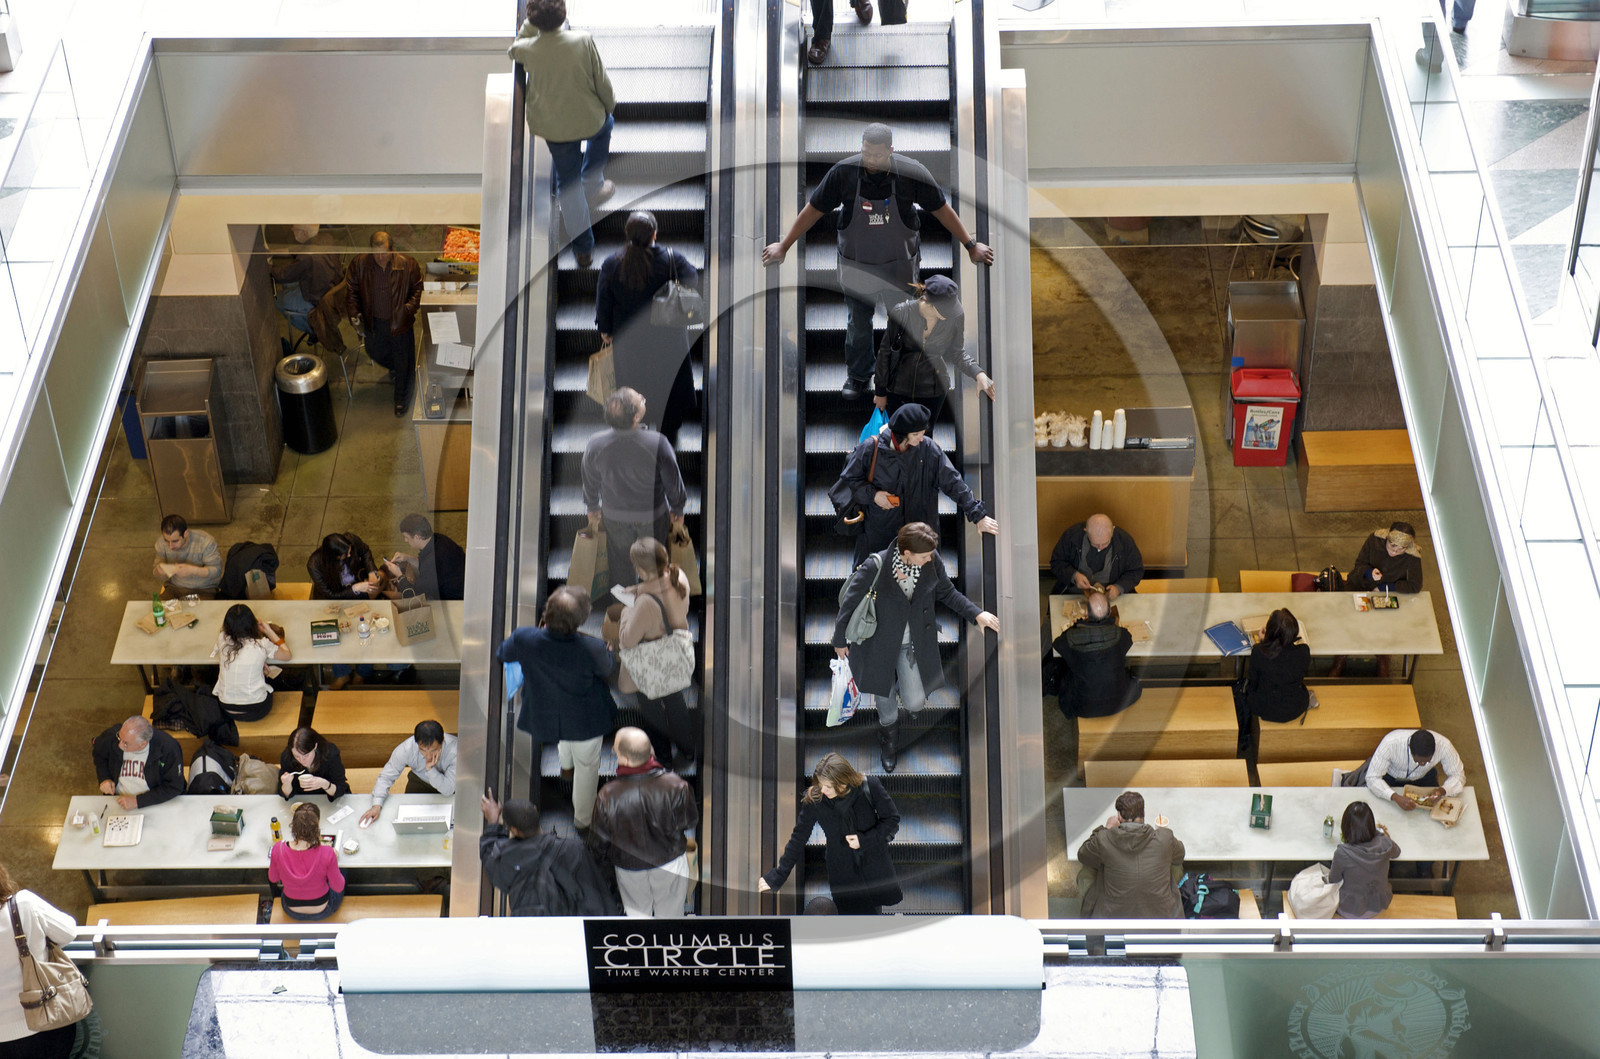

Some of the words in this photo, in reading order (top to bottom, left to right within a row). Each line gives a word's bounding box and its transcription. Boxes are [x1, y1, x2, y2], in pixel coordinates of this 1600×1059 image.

[120, 760, 145, 780] HICA
[603, 933, 774, 947] COLUMBUS
[604, 947, 775, 967] CIRCLE
[607, 969, 641, 977] TIME
[650, 968, 710, 977] WARNER
[718, 968, 775, 976] CENTER
